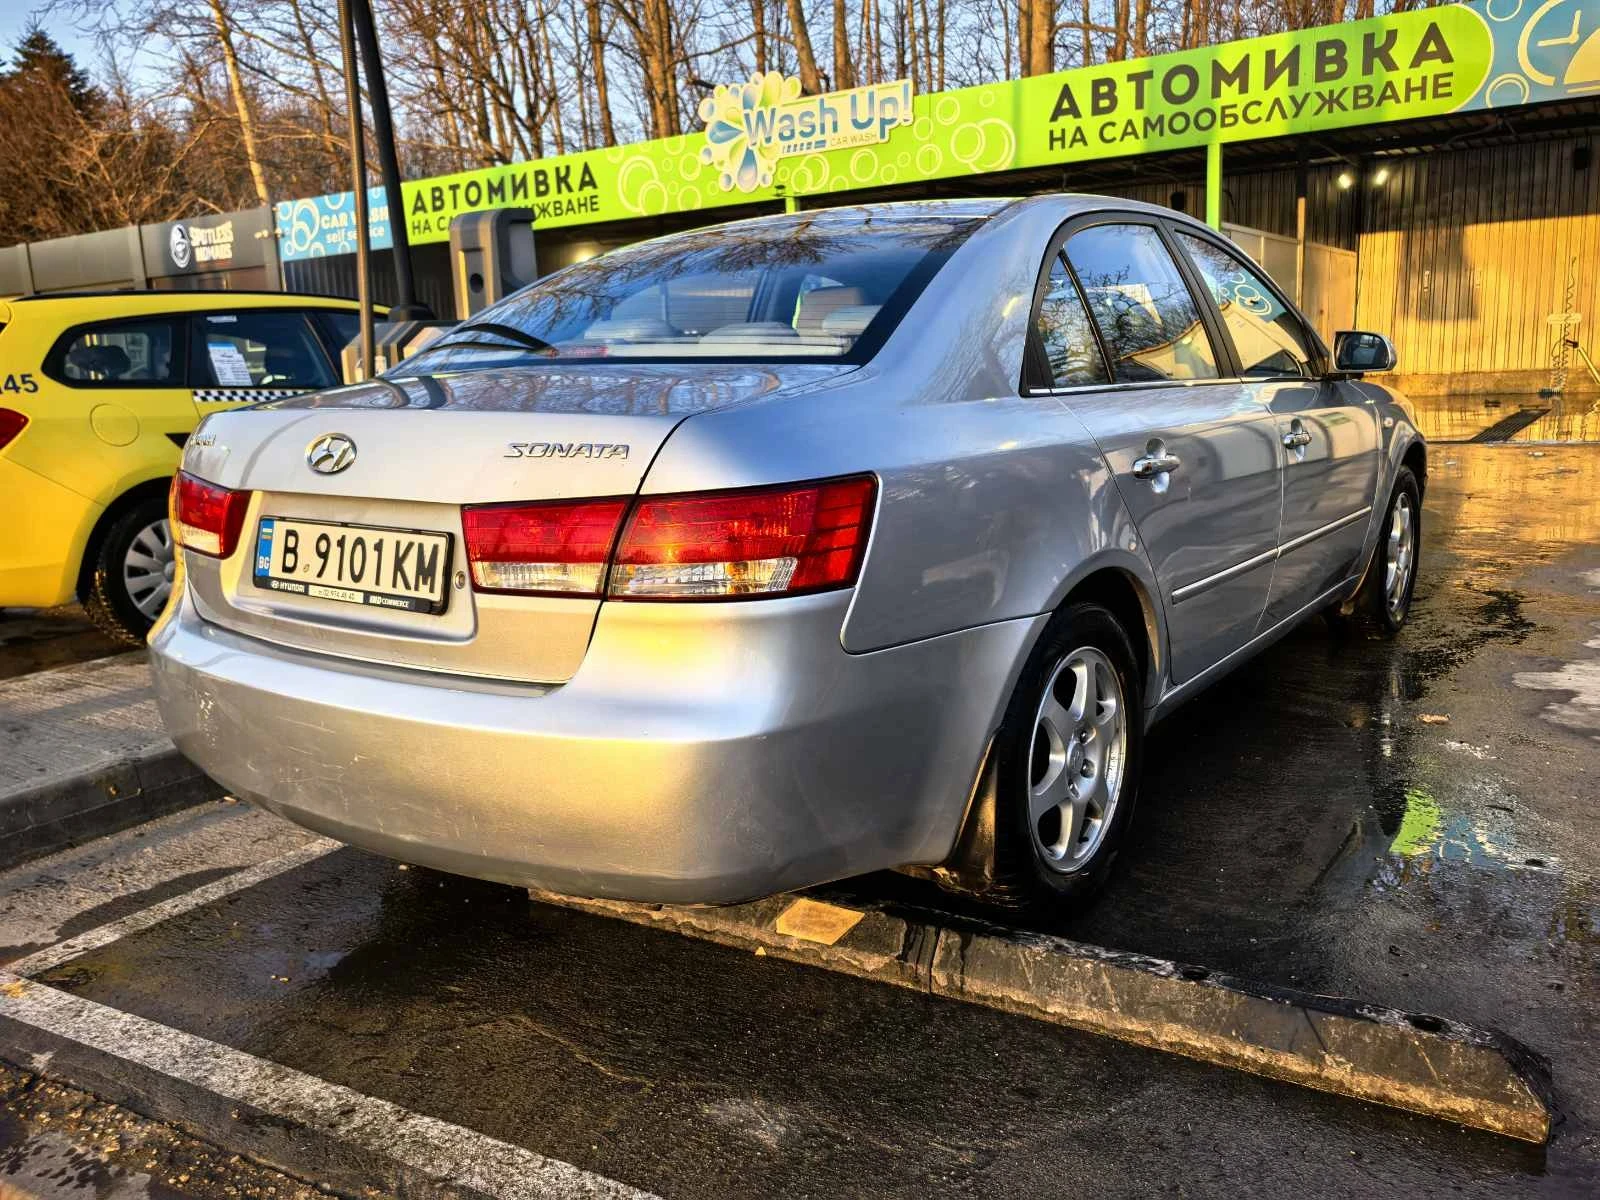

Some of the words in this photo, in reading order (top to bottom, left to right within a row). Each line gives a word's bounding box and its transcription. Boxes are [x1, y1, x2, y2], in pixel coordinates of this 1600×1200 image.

[1050, 21, 1453, 123] АВТОМИВКА
[744, 98, 838, 146] Wash
[851, 82, 910, 140] Up!
[1049, 126, 1088, 150] НА
[1098, 71, 1454, 144] САМООБСЛУЖВАНЕ
[831, 137, 849, 147] CAR
[851, 133, 877, 145] WASH
[412, 161, 598, 217] АВТОМИВКА
[321, 212, 349, 229] CAR
[412, 219, 432, 235] НА
[326, 228, 344, 243] self
[0, 373, 38, 394] 45
[503, 442, 630, 460] SONATA
[281, 528, 300, 574] B
[258, 555, 270, 570] BG
[280, 581, 305, 593] HYUNDAI
